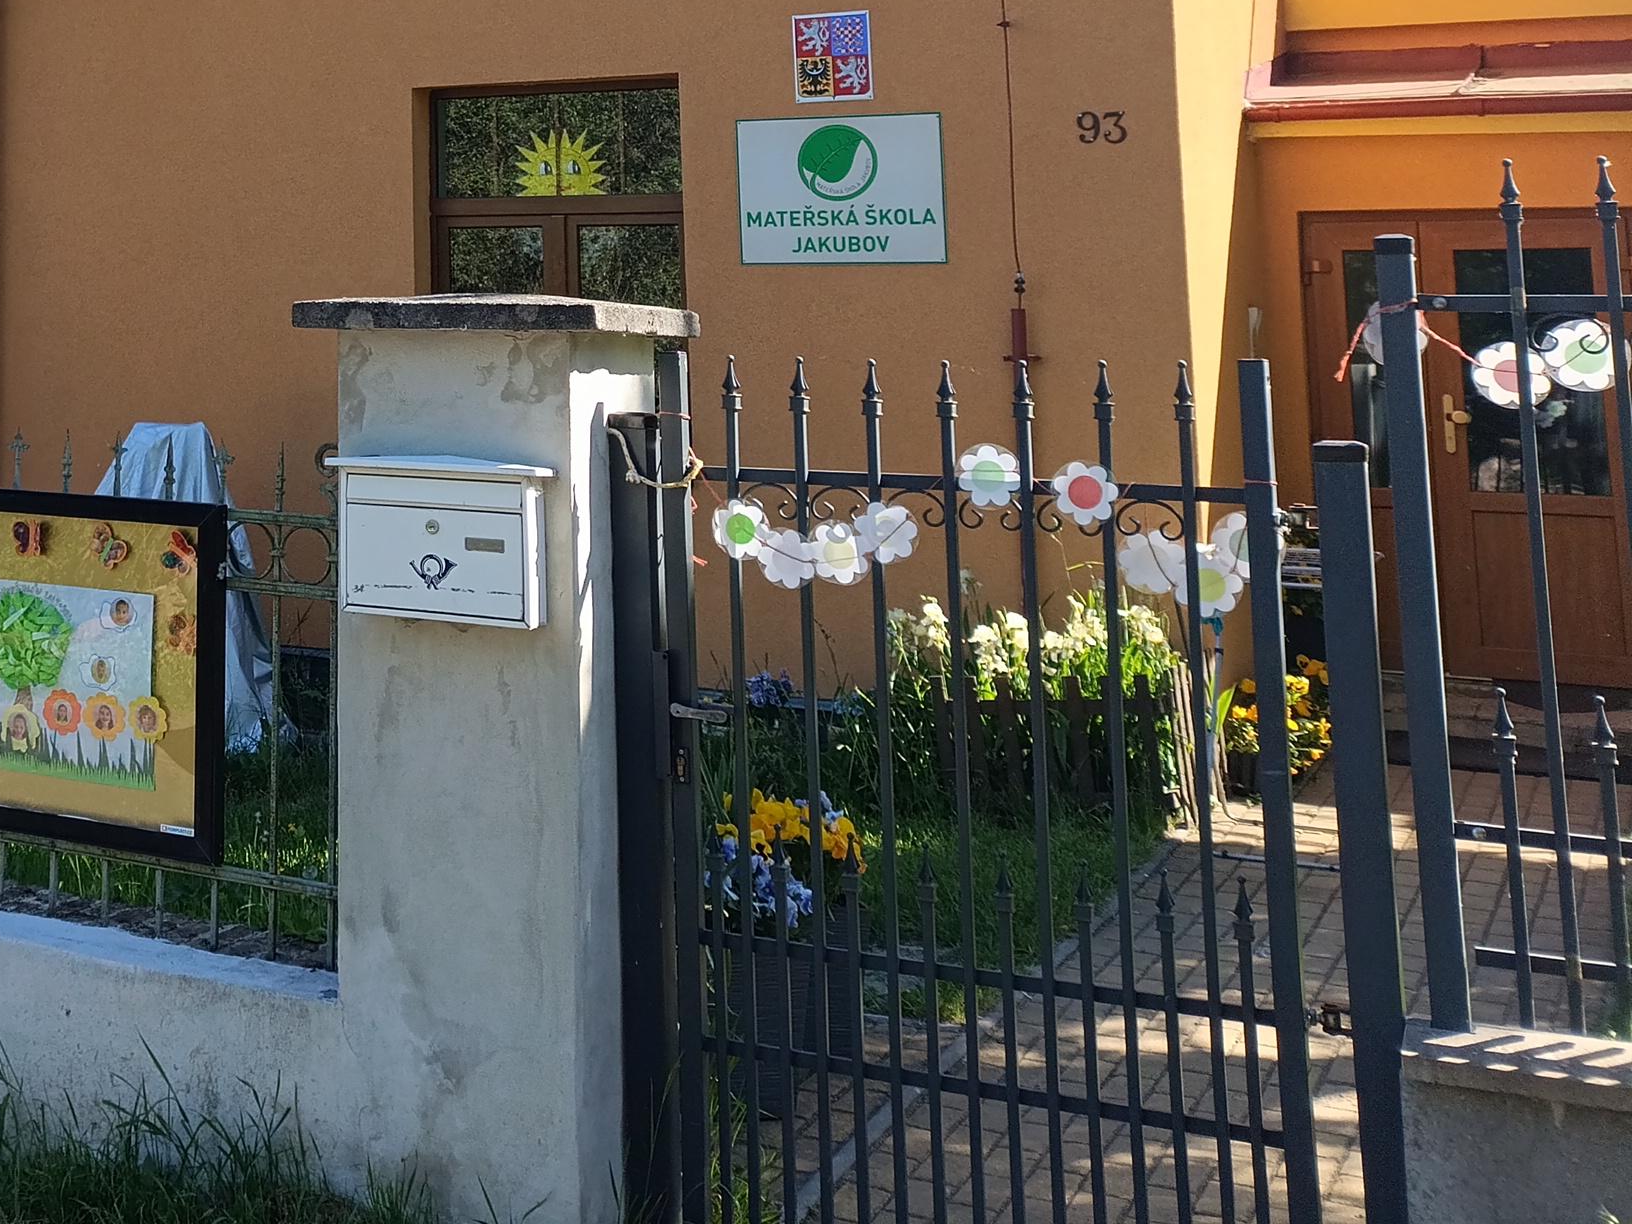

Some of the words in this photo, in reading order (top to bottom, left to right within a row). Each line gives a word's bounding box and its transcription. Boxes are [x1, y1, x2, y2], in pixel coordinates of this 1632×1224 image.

[1076, 110, 1128, 145] 93
[747, 205, 859, 227] MATEŘSKÁ
[865, 203, 936, 225] ŠKOLA
[792, 235, 889, 253] JAKUBOV
